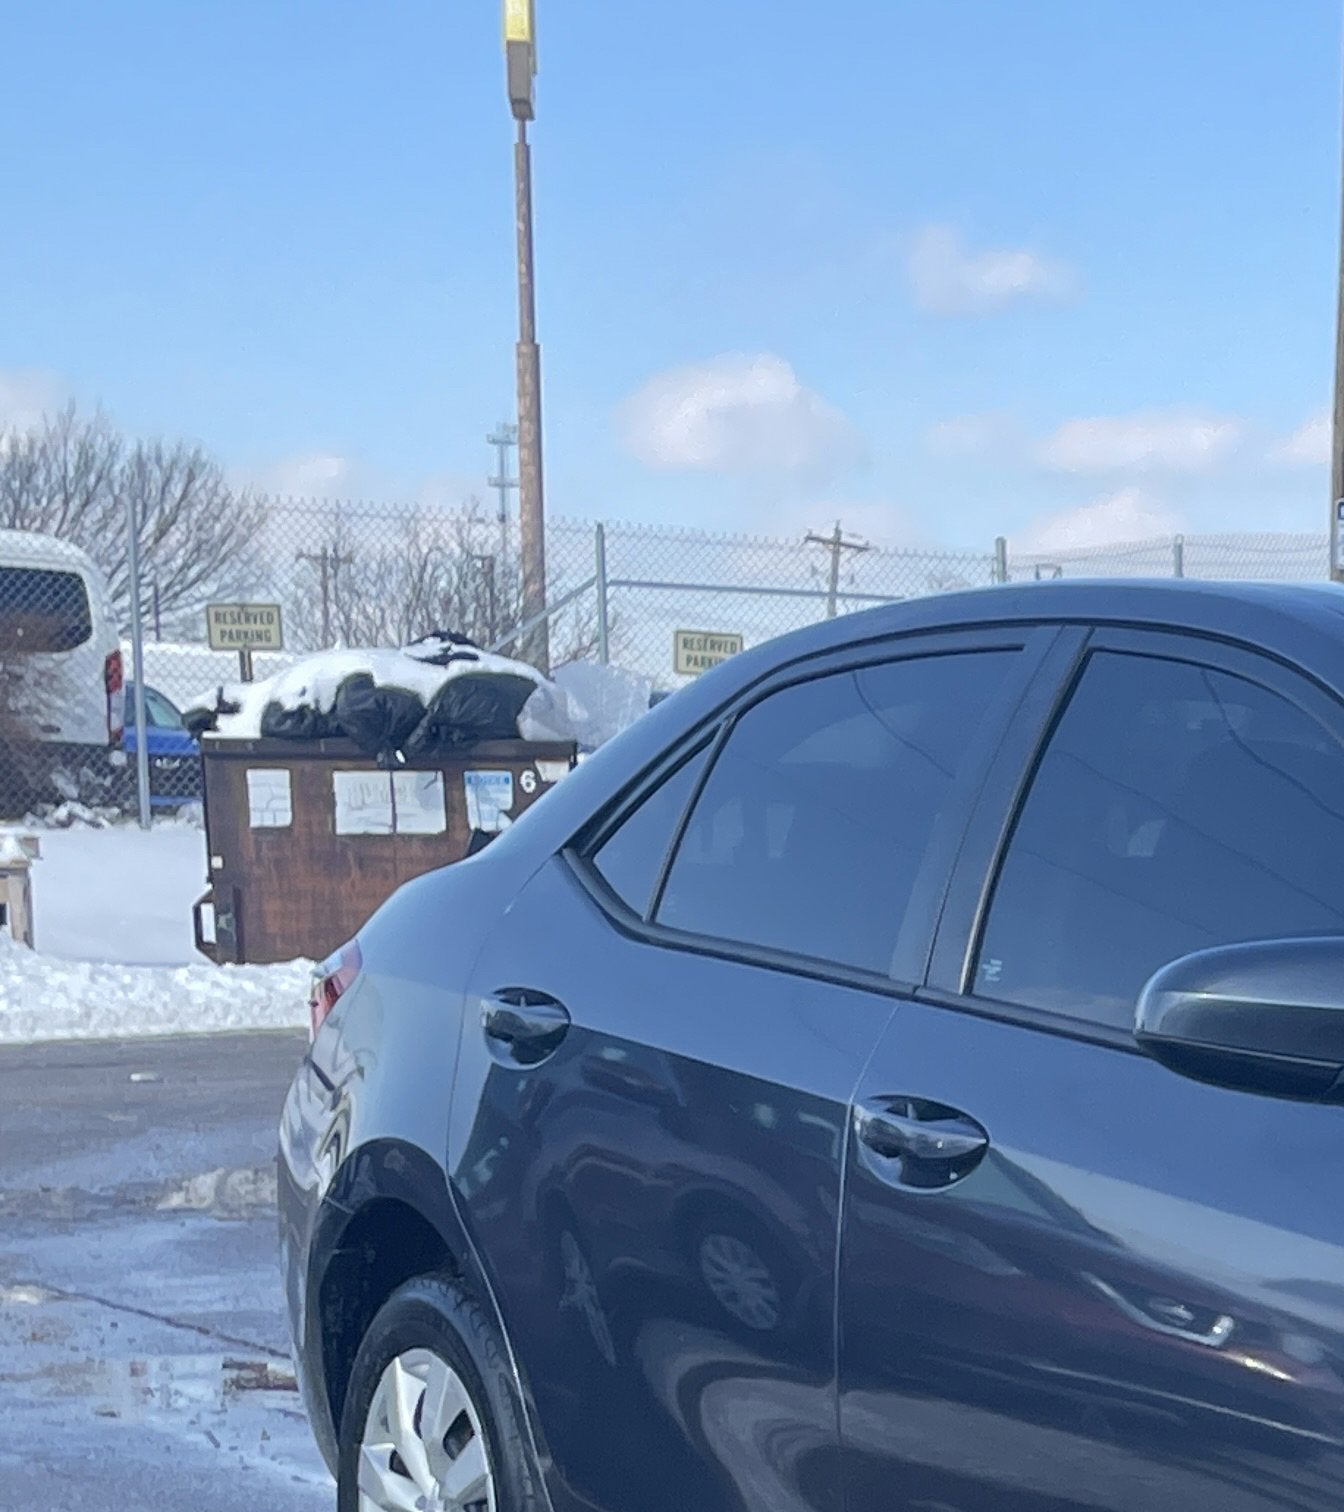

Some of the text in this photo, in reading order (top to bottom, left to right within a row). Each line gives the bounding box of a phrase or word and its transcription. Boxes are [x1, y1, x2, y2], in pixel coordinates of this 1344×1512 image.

[214, 610, 274, 626] RESERVED
[220, 629, 272, 643] PARKING
[682, 637, 738, 655] RESERVED
[520, 770, 537, 793] 6
